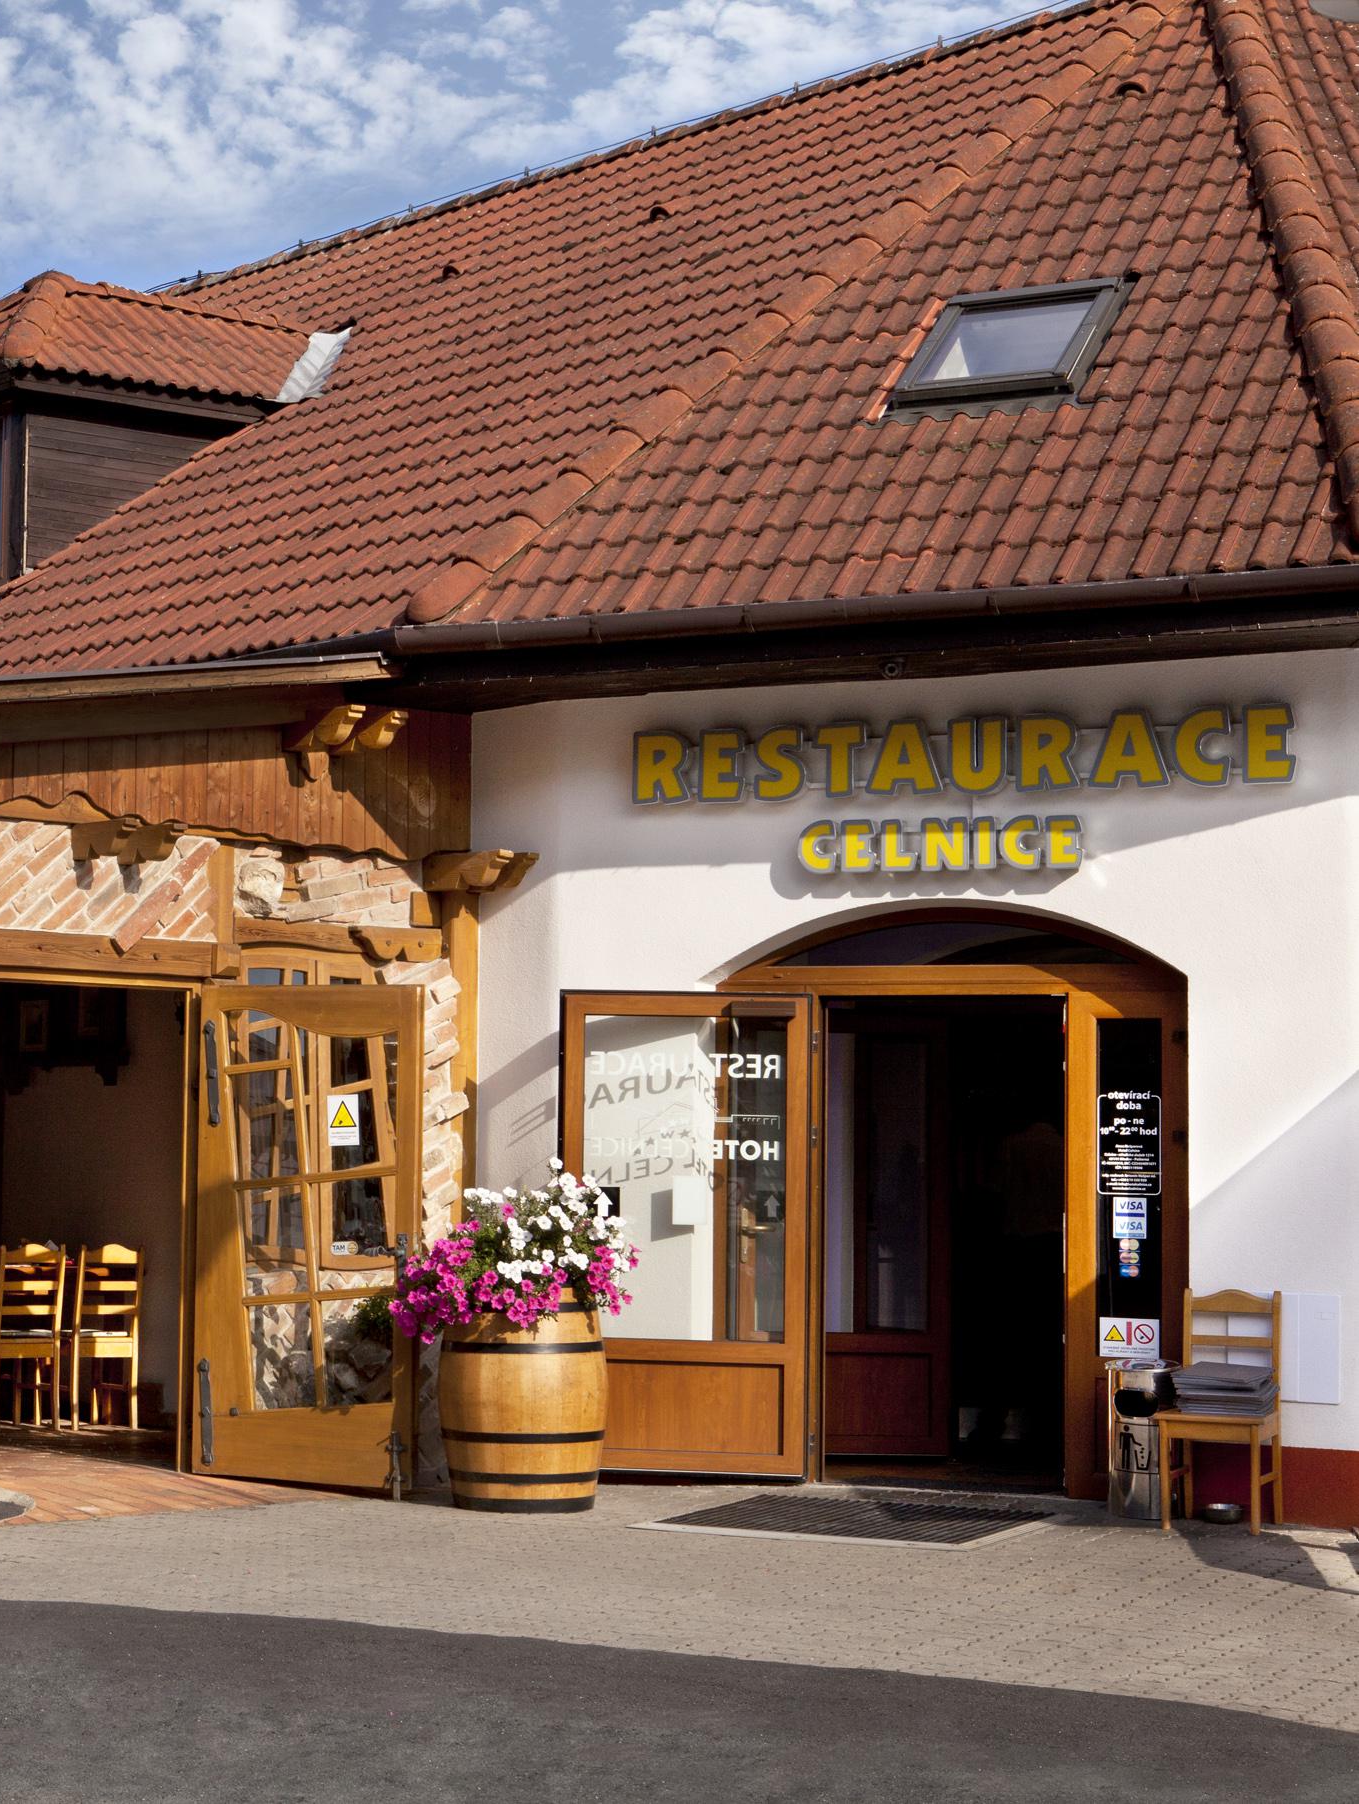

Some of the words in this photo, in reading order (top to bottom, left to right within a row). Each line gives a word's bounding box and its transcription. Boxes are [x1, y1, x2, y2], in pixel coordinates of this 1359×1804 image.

[631, 702, 1297, 806] RESTAURACE
[797, 814, 1084, 875] CELNICE
[1107, 1090, 1151, 1100] otevírací
[1116, 1101, 1142, 1110] doba
[1113, 1117, 1127, 1126] po
[1139, 1127, 1158, 1136] hod
[1119, 1201, 1143, 1211] VISA
[1119, 1221, 1143, 1231] VISA
